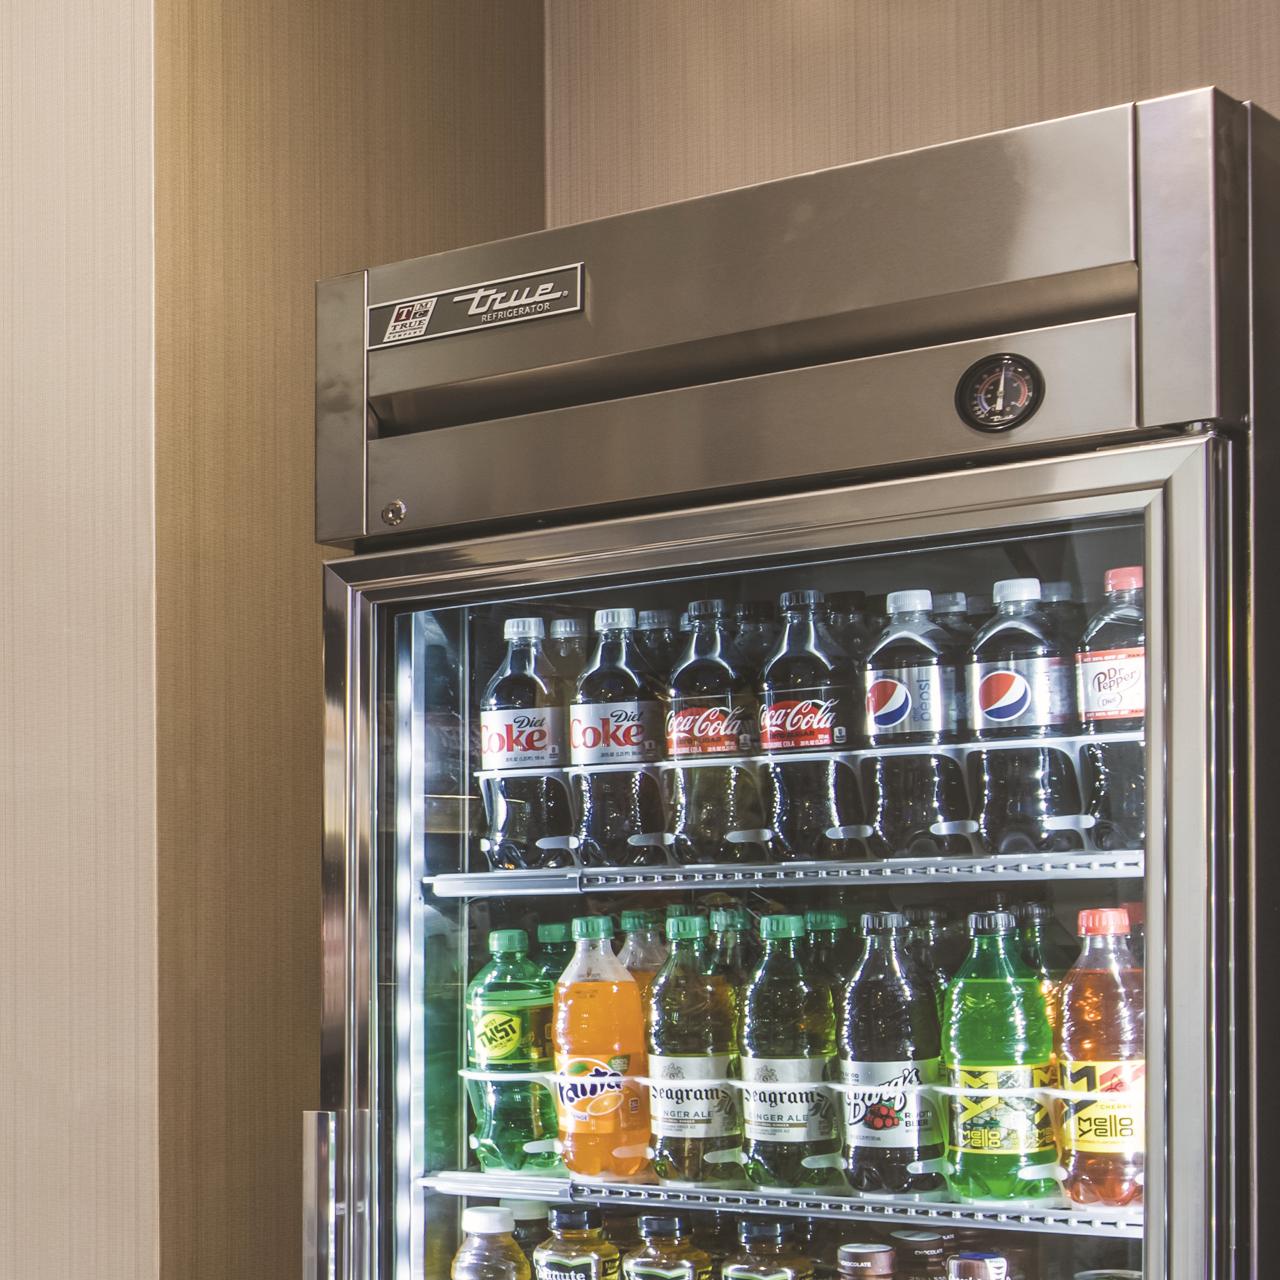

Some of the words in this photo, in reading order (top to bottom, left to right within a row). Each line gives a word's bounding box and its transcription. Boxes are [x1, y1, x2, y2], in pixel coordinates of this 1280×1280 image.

[481, 303, 550, 322] REFRIGERATOR
[391, 319, 426, 331] TRUE
[1092, 668, 1138, 693] Pepper
[1107, 666, 1125, 679] Dr
[514, 715, 545, 729] Diet
[610, 709, 644, 723] Diet
[758, 699, 838, 733] Coca-Cola
[481, 722, 548, 753] Coke
[569, 718, 645, 749] Coke
[787, 1114, 809, 1122] ALE
